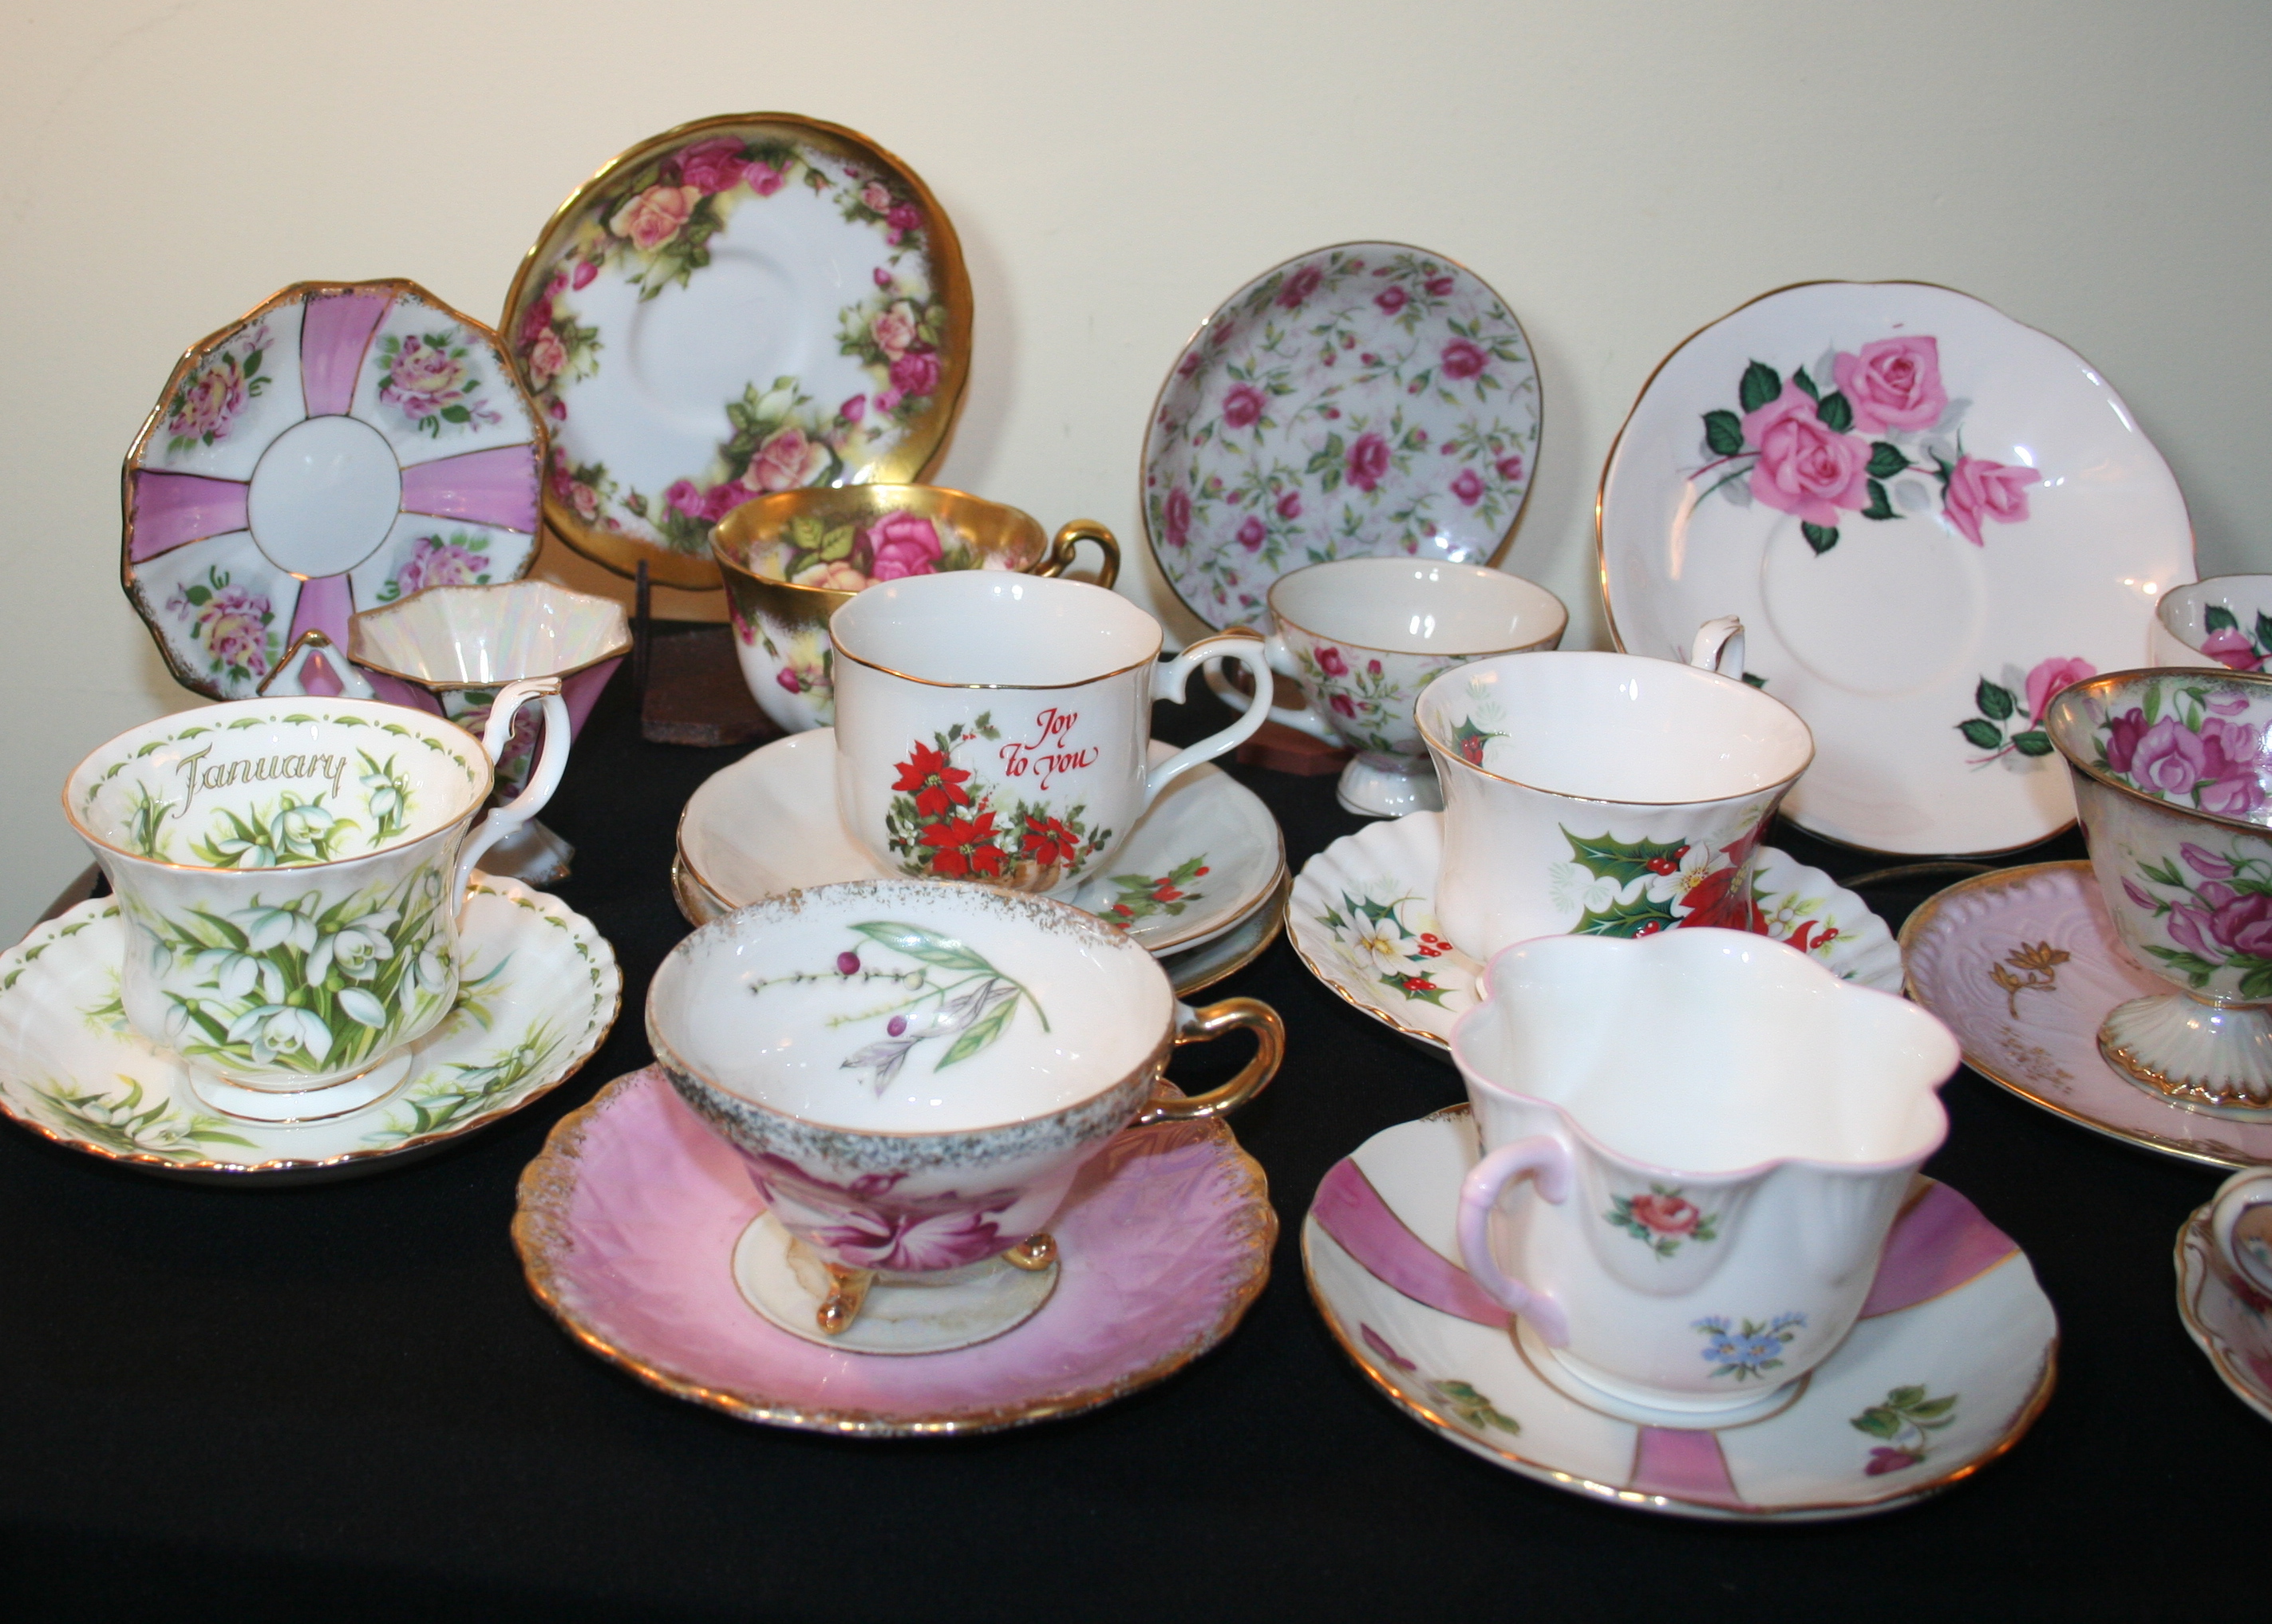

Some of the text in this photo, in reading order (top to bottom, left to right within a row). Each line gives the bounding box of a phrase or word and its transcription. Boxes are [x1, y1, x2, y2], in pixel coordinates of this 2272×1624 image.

[1025, 707, 1077, 750] Joy
[172, 742, 346, 819] January
[1033, 747, 1098, 790] you
